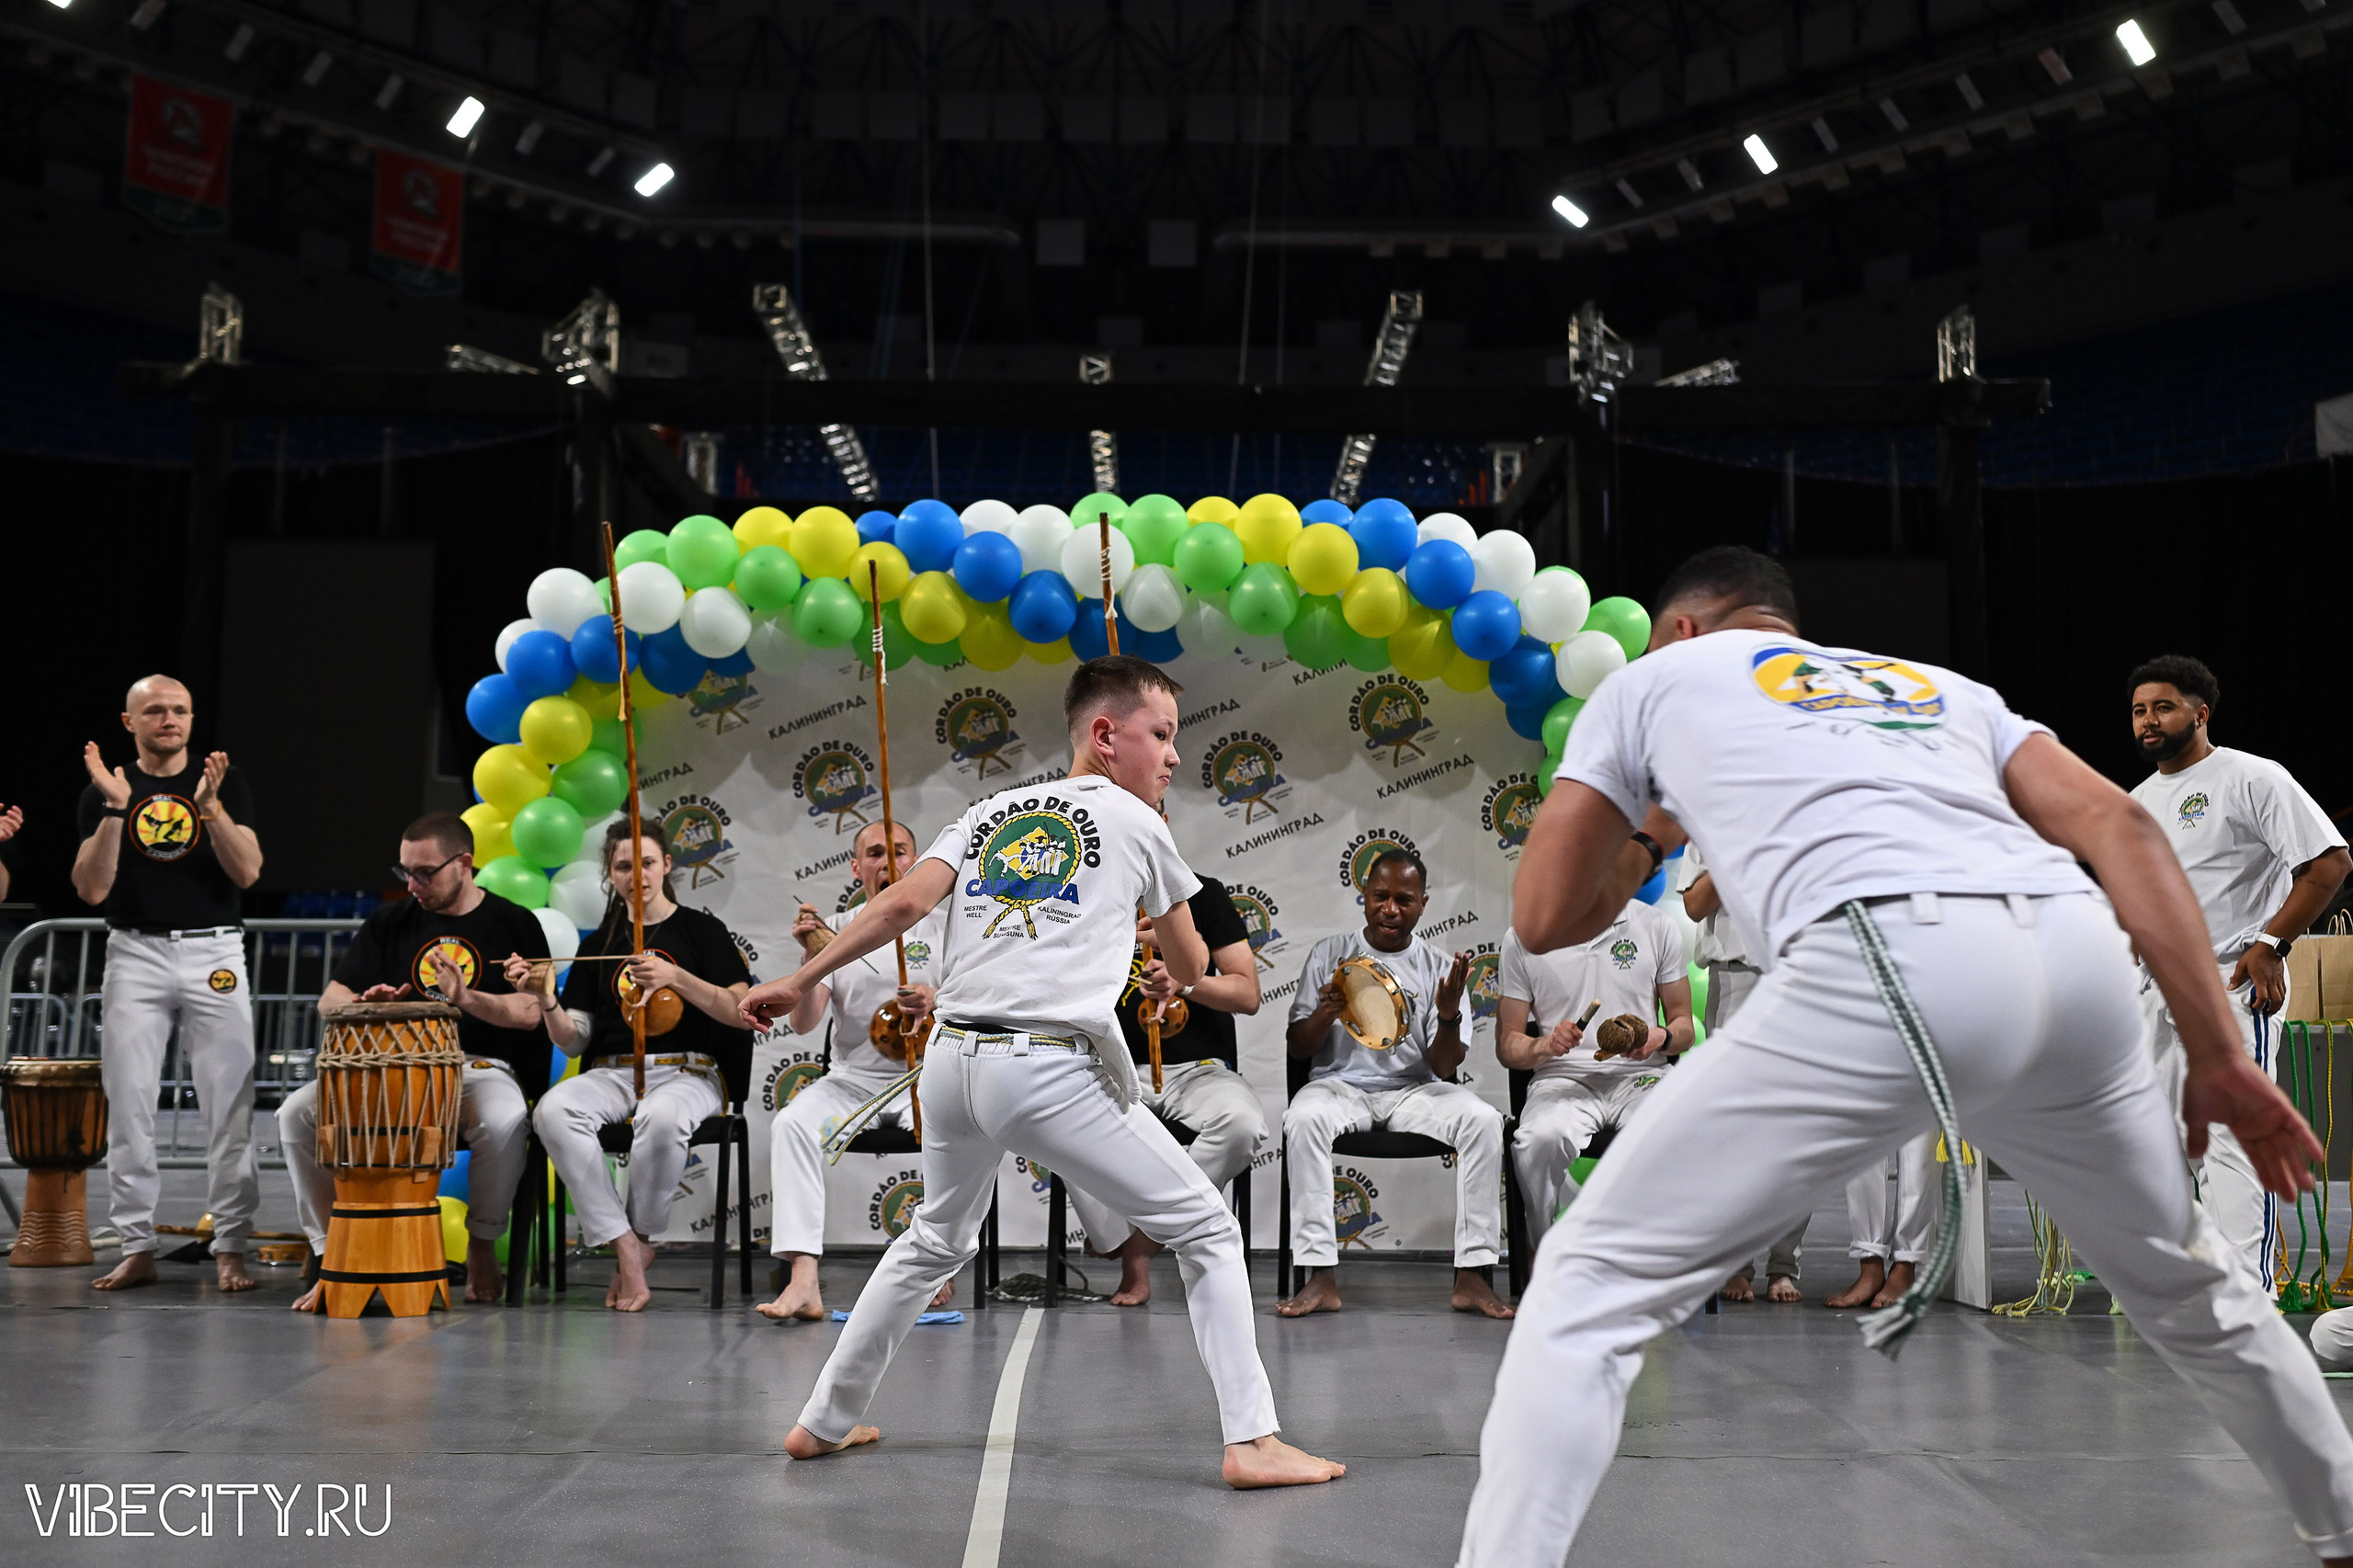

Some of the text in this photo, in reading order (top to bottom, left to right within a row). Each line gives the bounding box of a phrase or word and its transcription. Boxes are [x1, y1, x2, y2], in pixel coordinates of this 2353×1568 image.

[965, 687, 982, 699] DE
[985, 688, 1017, 719] OURO
[1377, 674, 1394, 685] DE
[1398, 676, 1429, 706] OURO
[767, 694, 867, 740] КАЛИНИНГРАД
[1177, 698, 1240, 731] НИНГРАД
[822, 740, 840, 752] DE
[843, 742, 874, 772] OURO
[1230, 730, 1248, 742] DE
[1251, 733, 1283, 762] OURO
[638, 762, 694, 790] ИНГРАД
[1376, 754, 1474, 800] КАЛИНИНГРАД
[679, 794, 697, 806] DE
[700, 797, 732, 827] OURO
[965, 796, 1101, 869] CORDÃO DE OURO
[1225, 812, 1324, 858] КАЛИНИНГРАД
[794, 848, 856, 881] КАЛИНИ
[1339, 835, 1366, 887] CORDÃO
[1368, 828, 1386, 839] DE
[835, 879, 863, 913] RDÃO
[965, 879, 1080, 905] CAPOEIRA
[1226, 884, 1279, 915] DE OURO
[1037, 905, 1082, 919] KALININGRAD
[1415, 910, 1479, 941] НИНГРАД
[1477, 942, 1495, 954] DE
[793, 1051, 811, 1062] DE
[899, 1169, 917, 1181] DE
[1346, 1167, 1379, 1199] OURO
